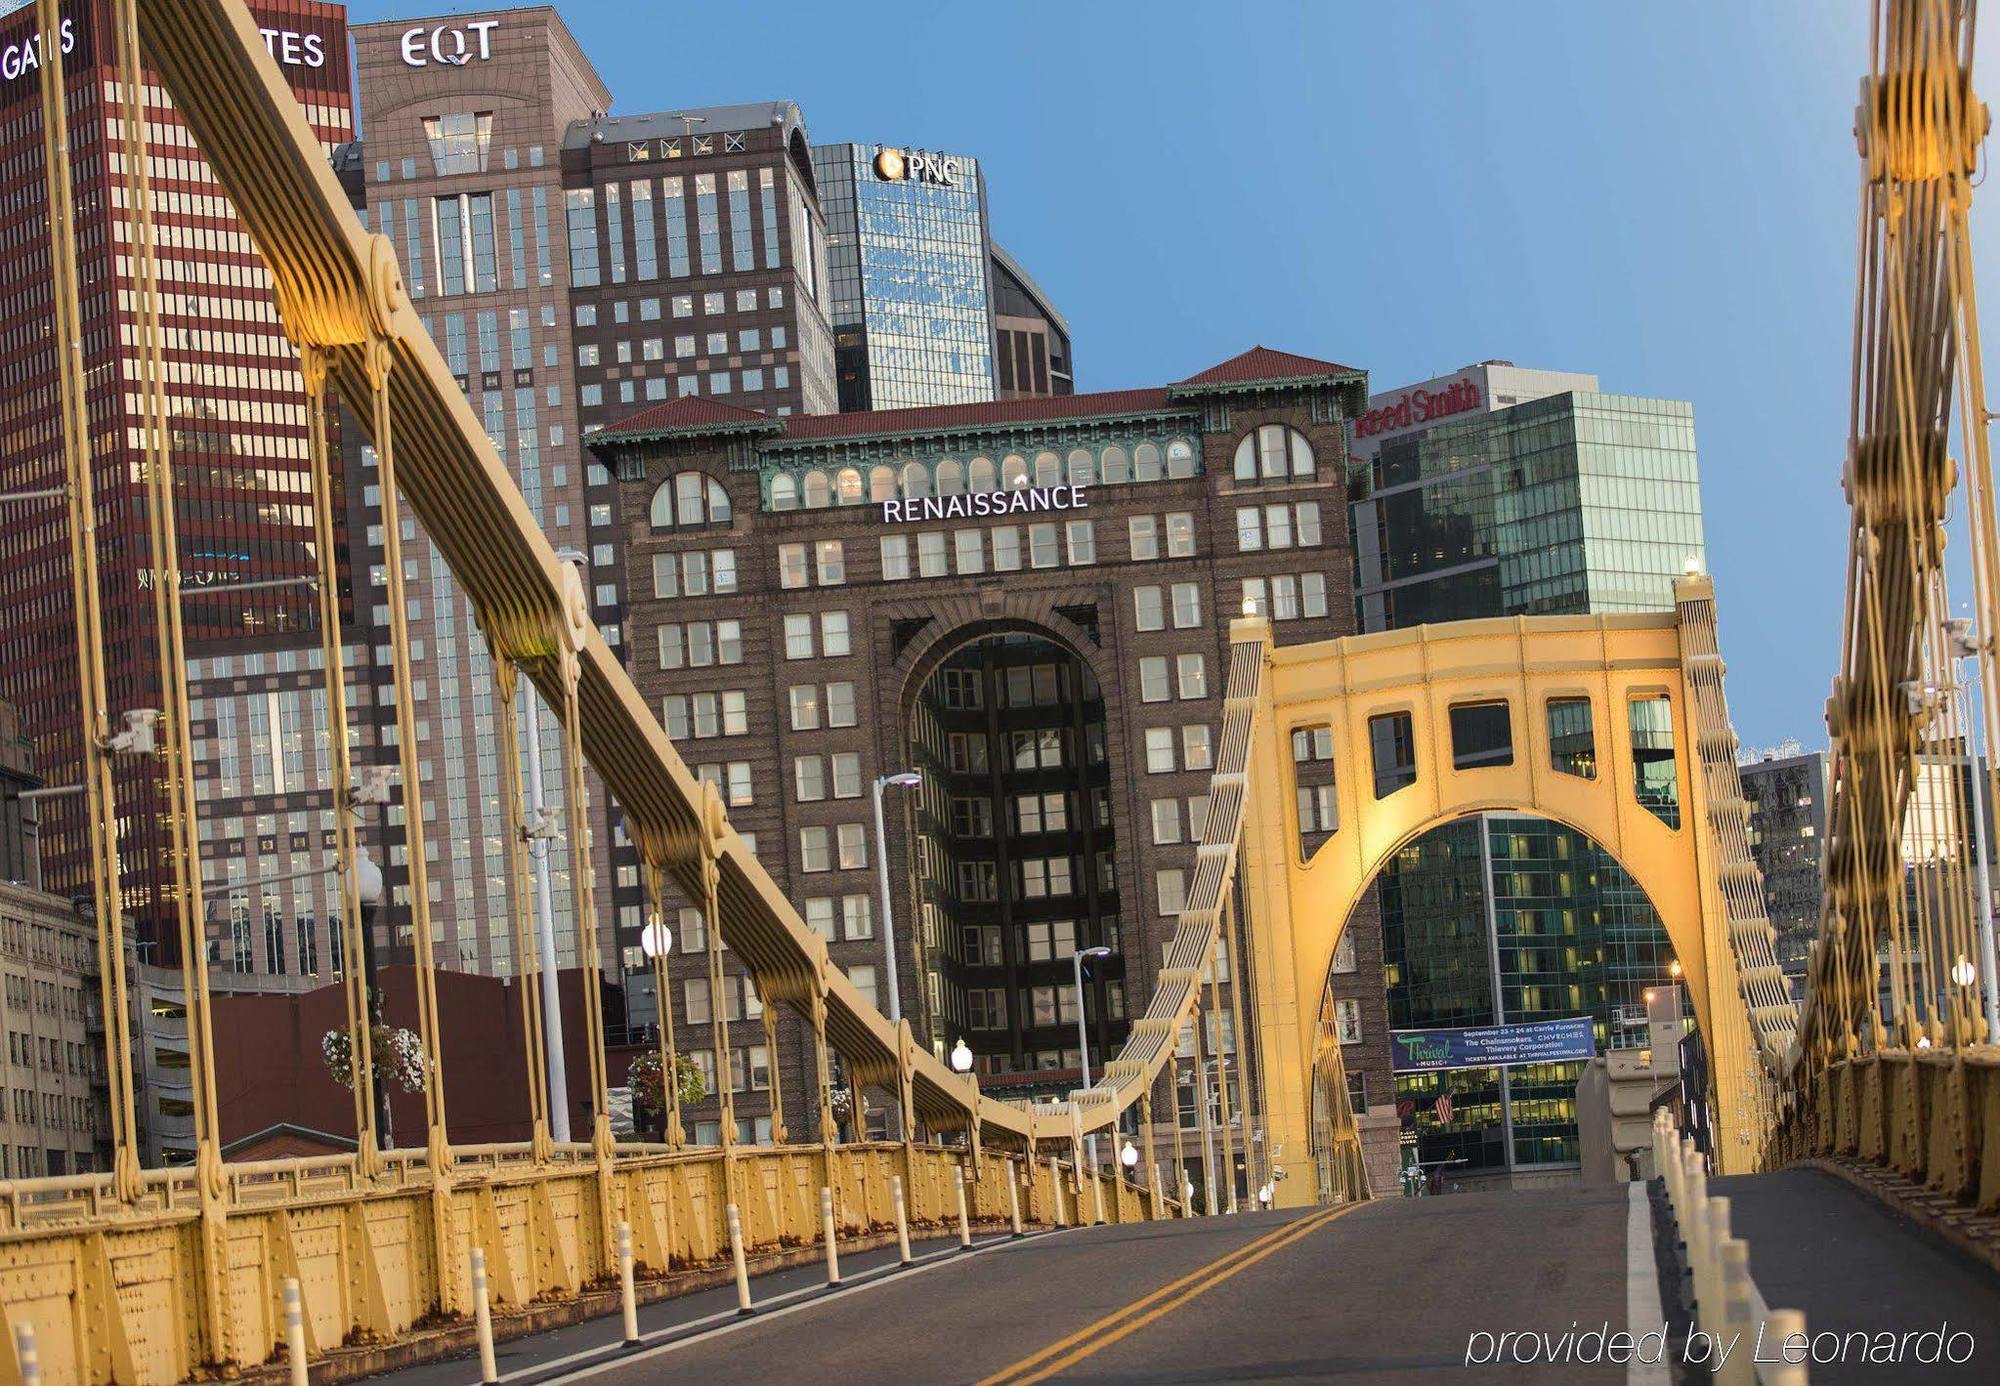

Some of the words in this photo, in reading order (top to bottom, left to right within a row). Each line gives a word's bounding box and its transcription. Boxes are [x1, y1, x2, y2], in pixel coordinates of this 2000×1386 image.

[401, 20, 499, 67] EQT
[903, 154, 961, 185] PNC
[1411, 378, 1481, 422] Smith
[883, 485, 1088, 523] RENAISSANCE
[1397, 1034, 1454, 1061] Thrival
[1463, 1030, 1499, 1038] September
[1464, 1039, 1479, 1047] The
[1479, 1036, 1533, 1046] Chainsmokers
[1485, 1045, 1517, 1053] Thievery
[1519, 1041, 1563, 1050] Corporation
[1487, 1053, 1517, 1061] AVAILABLE
